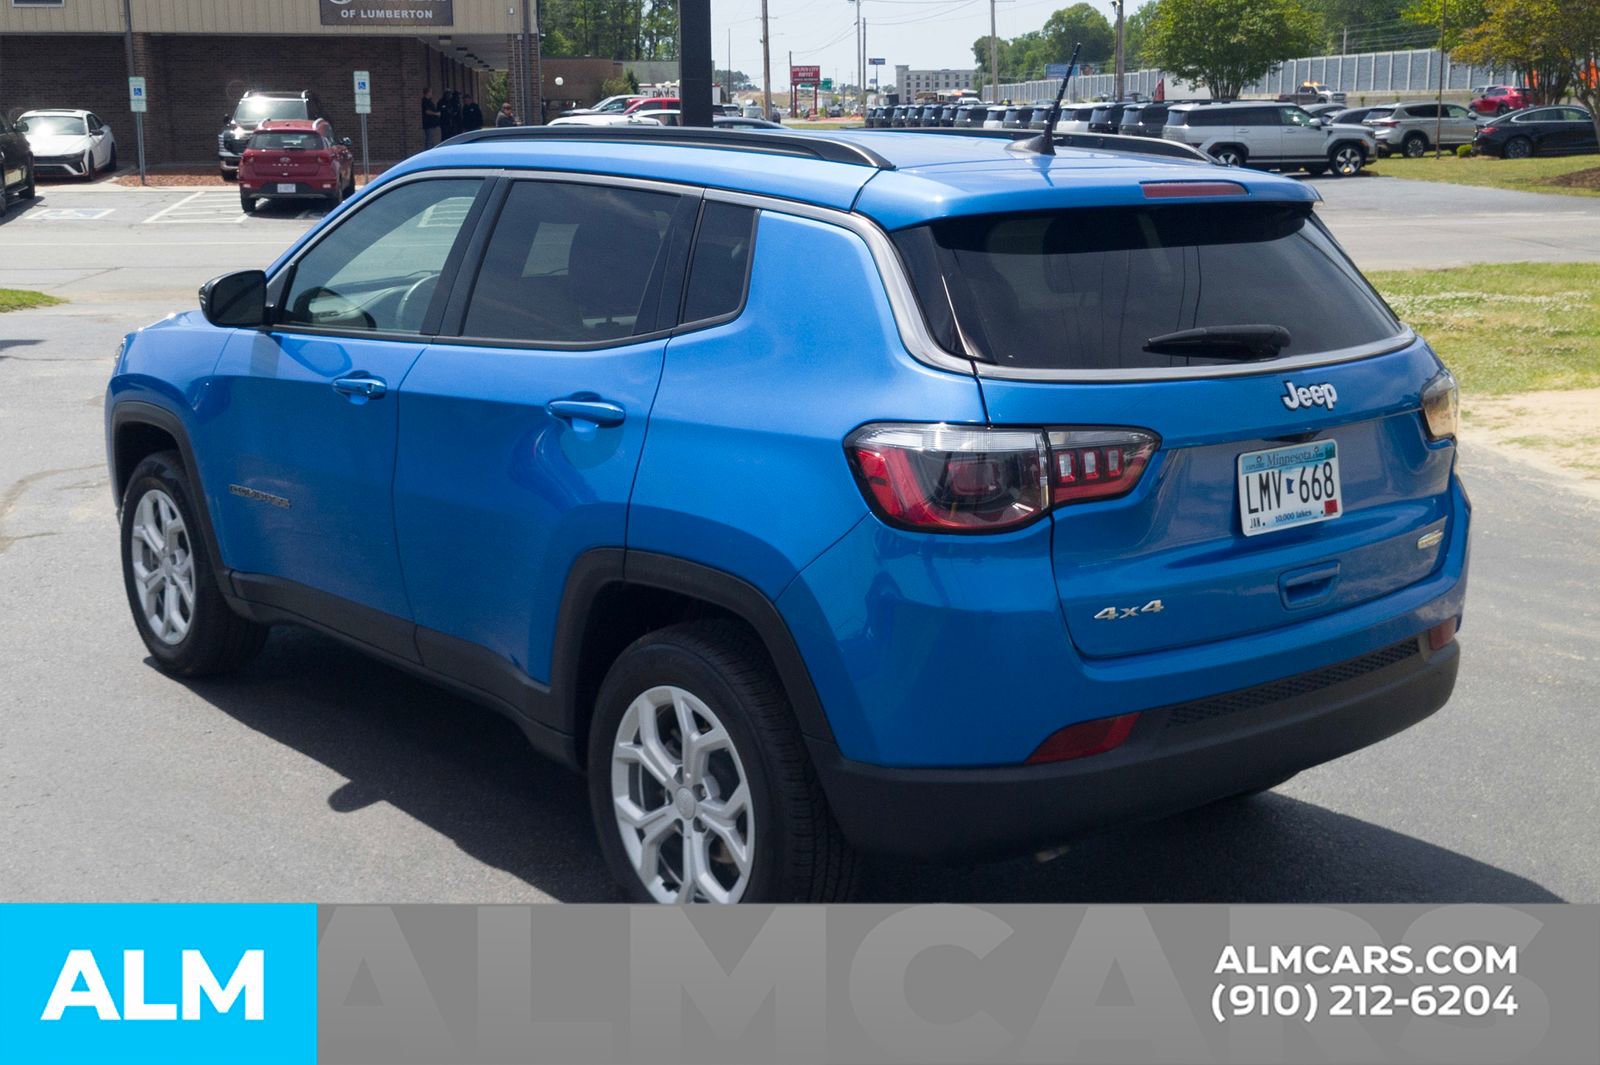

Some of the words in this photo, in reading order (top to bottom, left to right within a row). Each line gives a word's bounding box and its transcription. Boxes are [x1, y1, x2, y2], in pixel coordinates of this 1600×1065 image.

[341, 9, 356, 18] OF
[360, 9, 433, 19] LUMBERTON
[1282, 381, 1338, 409] Jeep
[1266, 449, 1312, 466] Minnesota
[1245, 469, 1282, 514] LMV
[1298, 461, 1335, 504] 668
[1295, 509, 1312, 519] lakes
